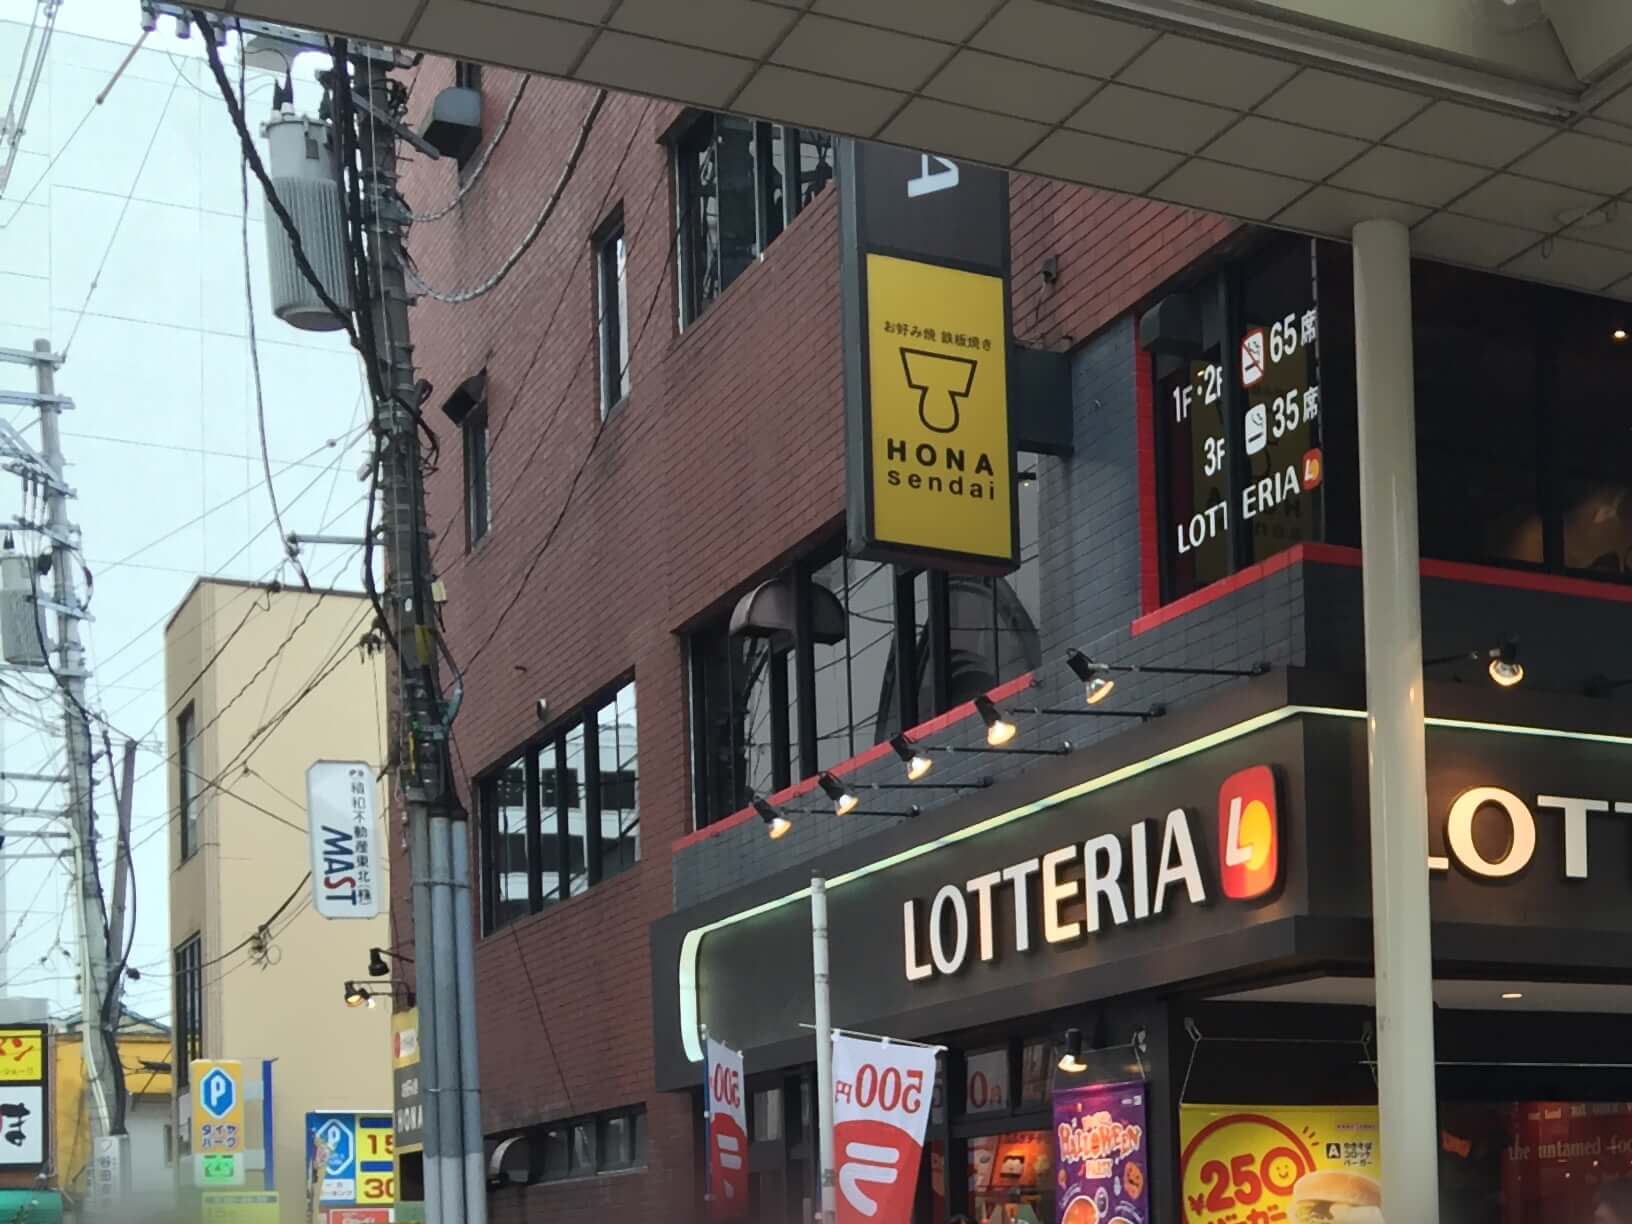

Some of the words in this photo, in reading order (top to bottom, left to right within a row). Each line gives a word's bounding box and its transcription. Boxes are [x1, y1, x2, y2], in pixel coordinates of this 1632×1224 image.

[1269, 309, 1318, 363] 65席
[1271, 385, 1319, 438] 35席
[887, 438, 994, 476] HONA
[1204, 437, 1225, 477] 3F
[321, 825, 357, 906] MAST
[904, 808, 1206, 982] LOTTERIA
[1538, 1130, 1601, 1159] untamed
